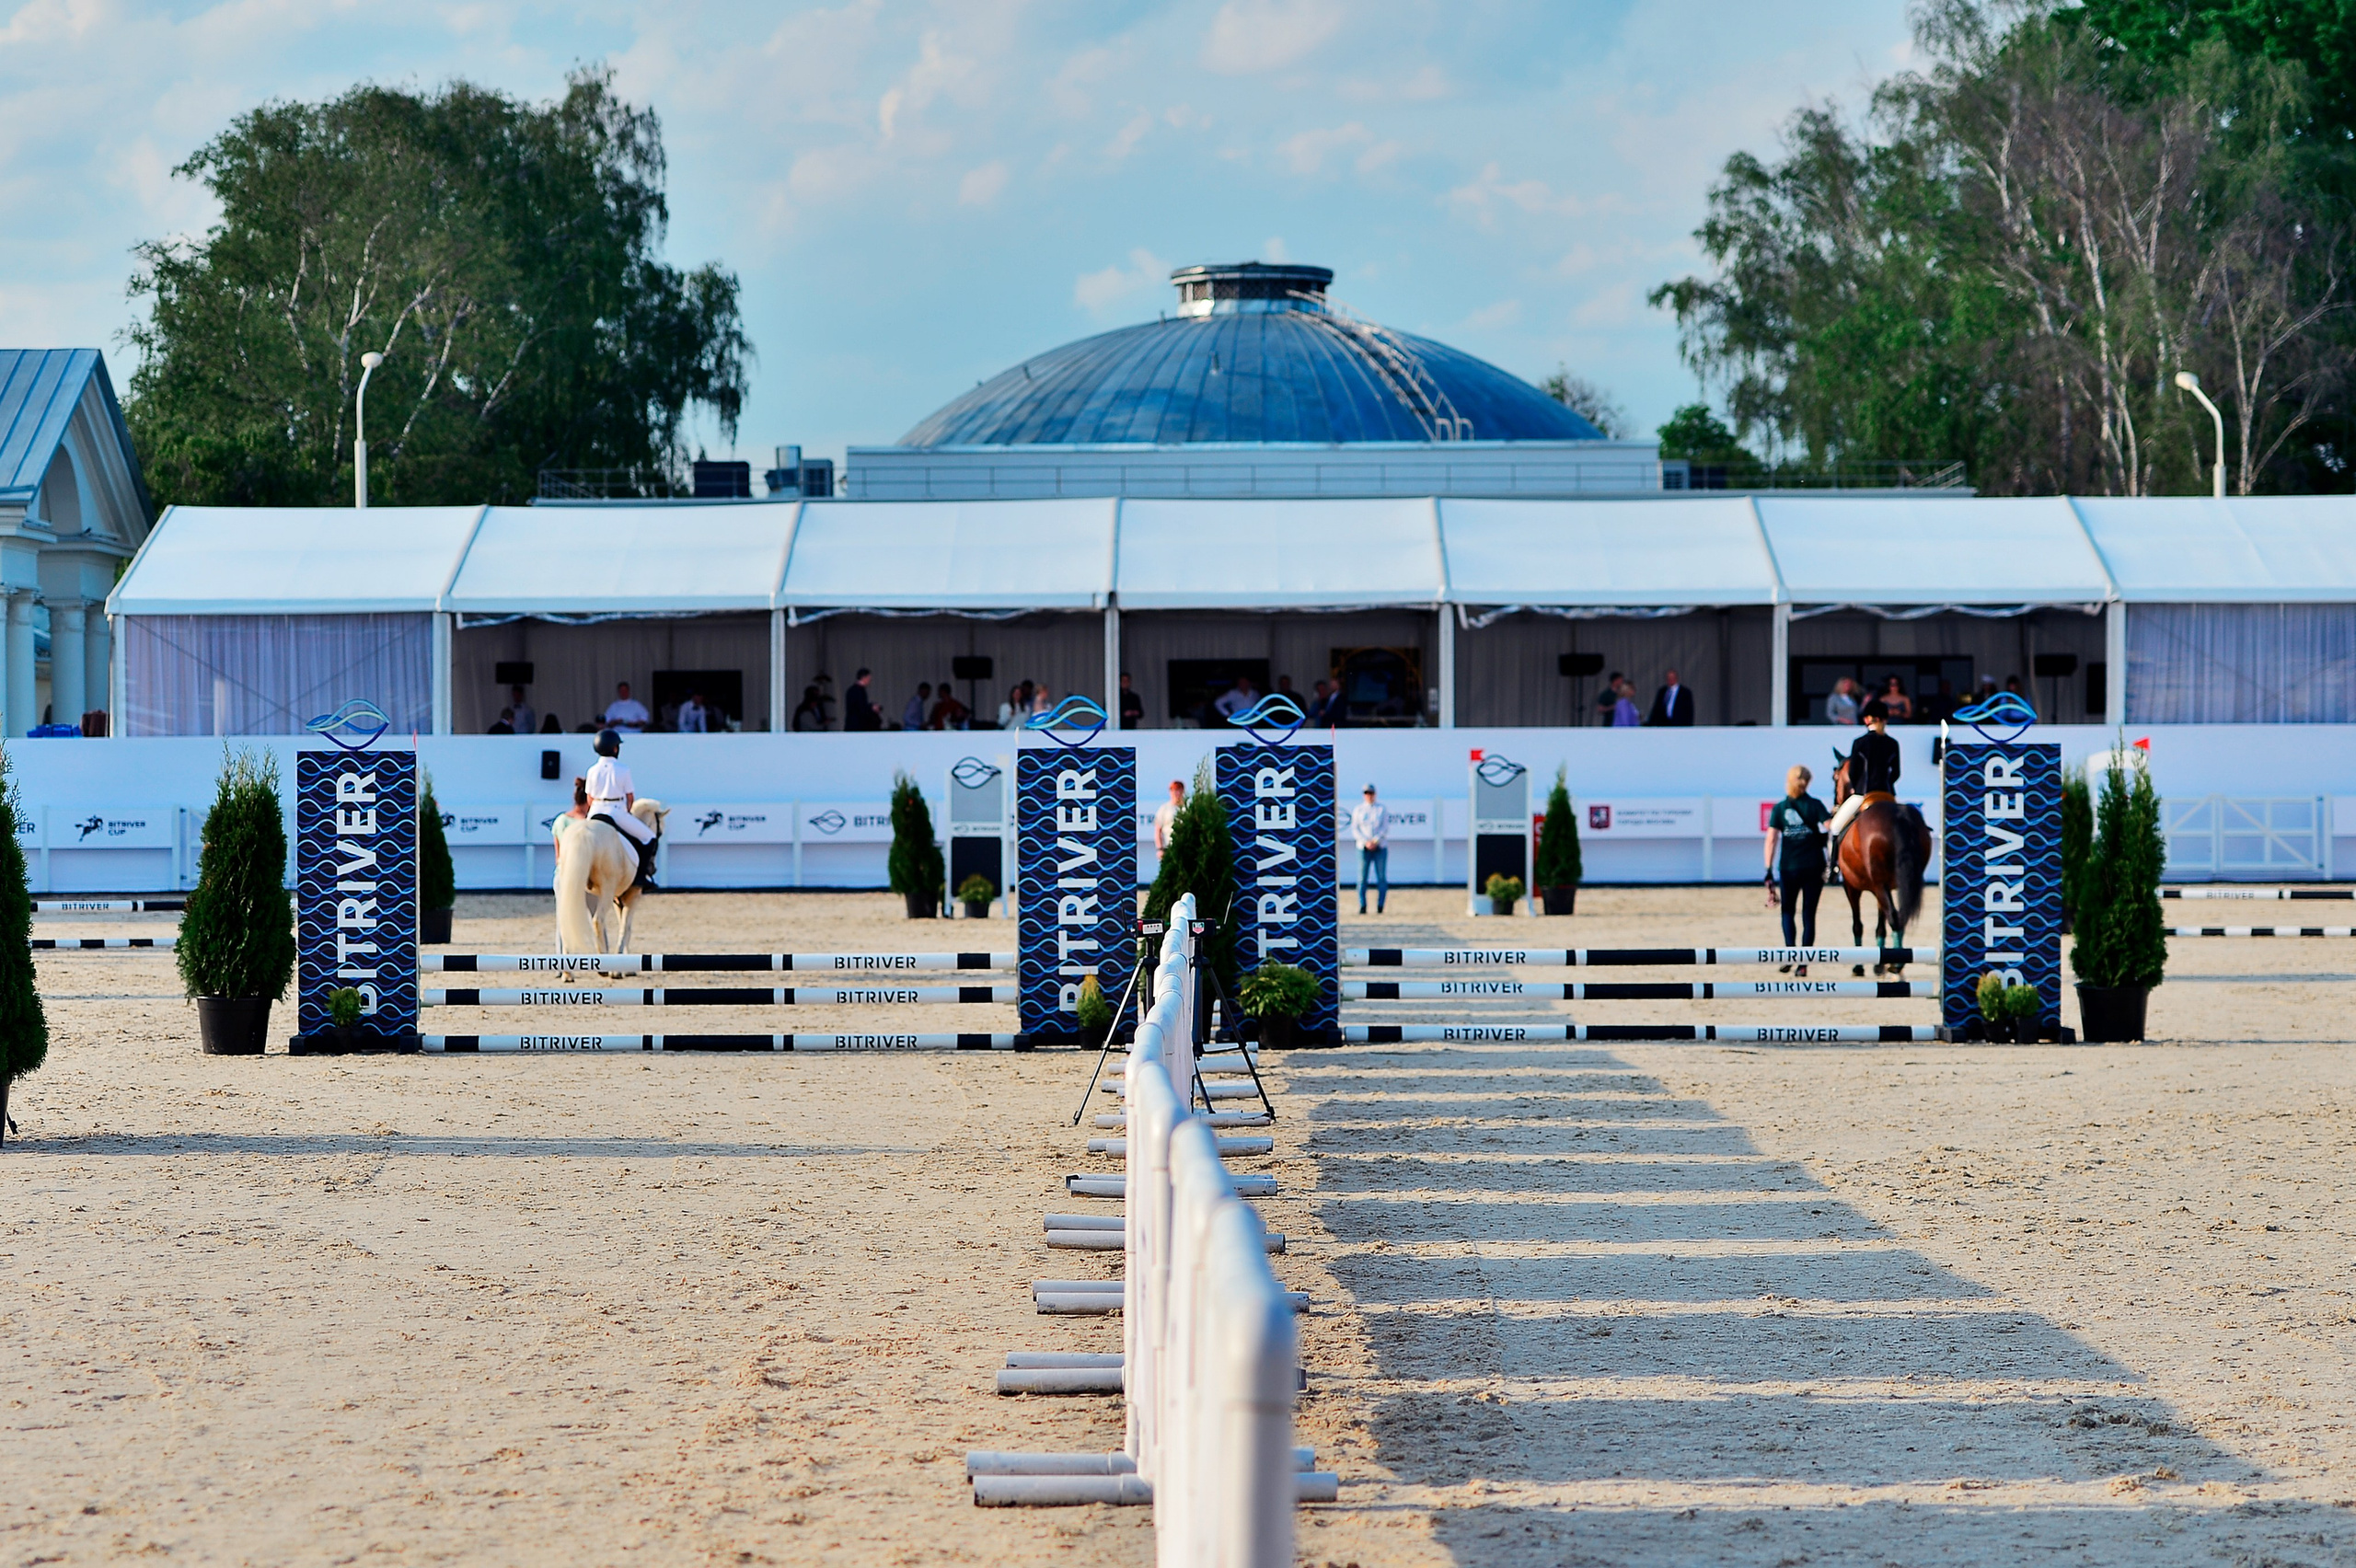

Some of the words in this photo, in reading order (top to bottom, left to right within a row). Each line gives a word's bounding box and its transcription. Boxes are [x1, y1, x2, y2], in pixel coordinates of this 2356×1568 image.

[1254, 766, 1299, 970] TRIVER
[62, 903, 110, 911] BITRIVER
[835, 956, 917, 969] BITRIVER
[1444, 951, 1526, 963] BITRIVER
[1758, 950, 1840, 963] BITRIVER
[519, 958, 601, 970] BITRIVER
[1441, 982, 1523, 993] BITRIVER
[1755, 982, 1836, 992] BITRIVER
[521, 992, 603, 1005] BITRIVER
[837, 991, 918, 1003] BITRIVER
[1443, 1028, 1526, 1041] BITRIVER
[1757, 1028, 1840, 1042] BITRIVER
[520, 1036, 603, 1049] BITRIVER
[835, 1035, 918, 1048] BITRIVER
